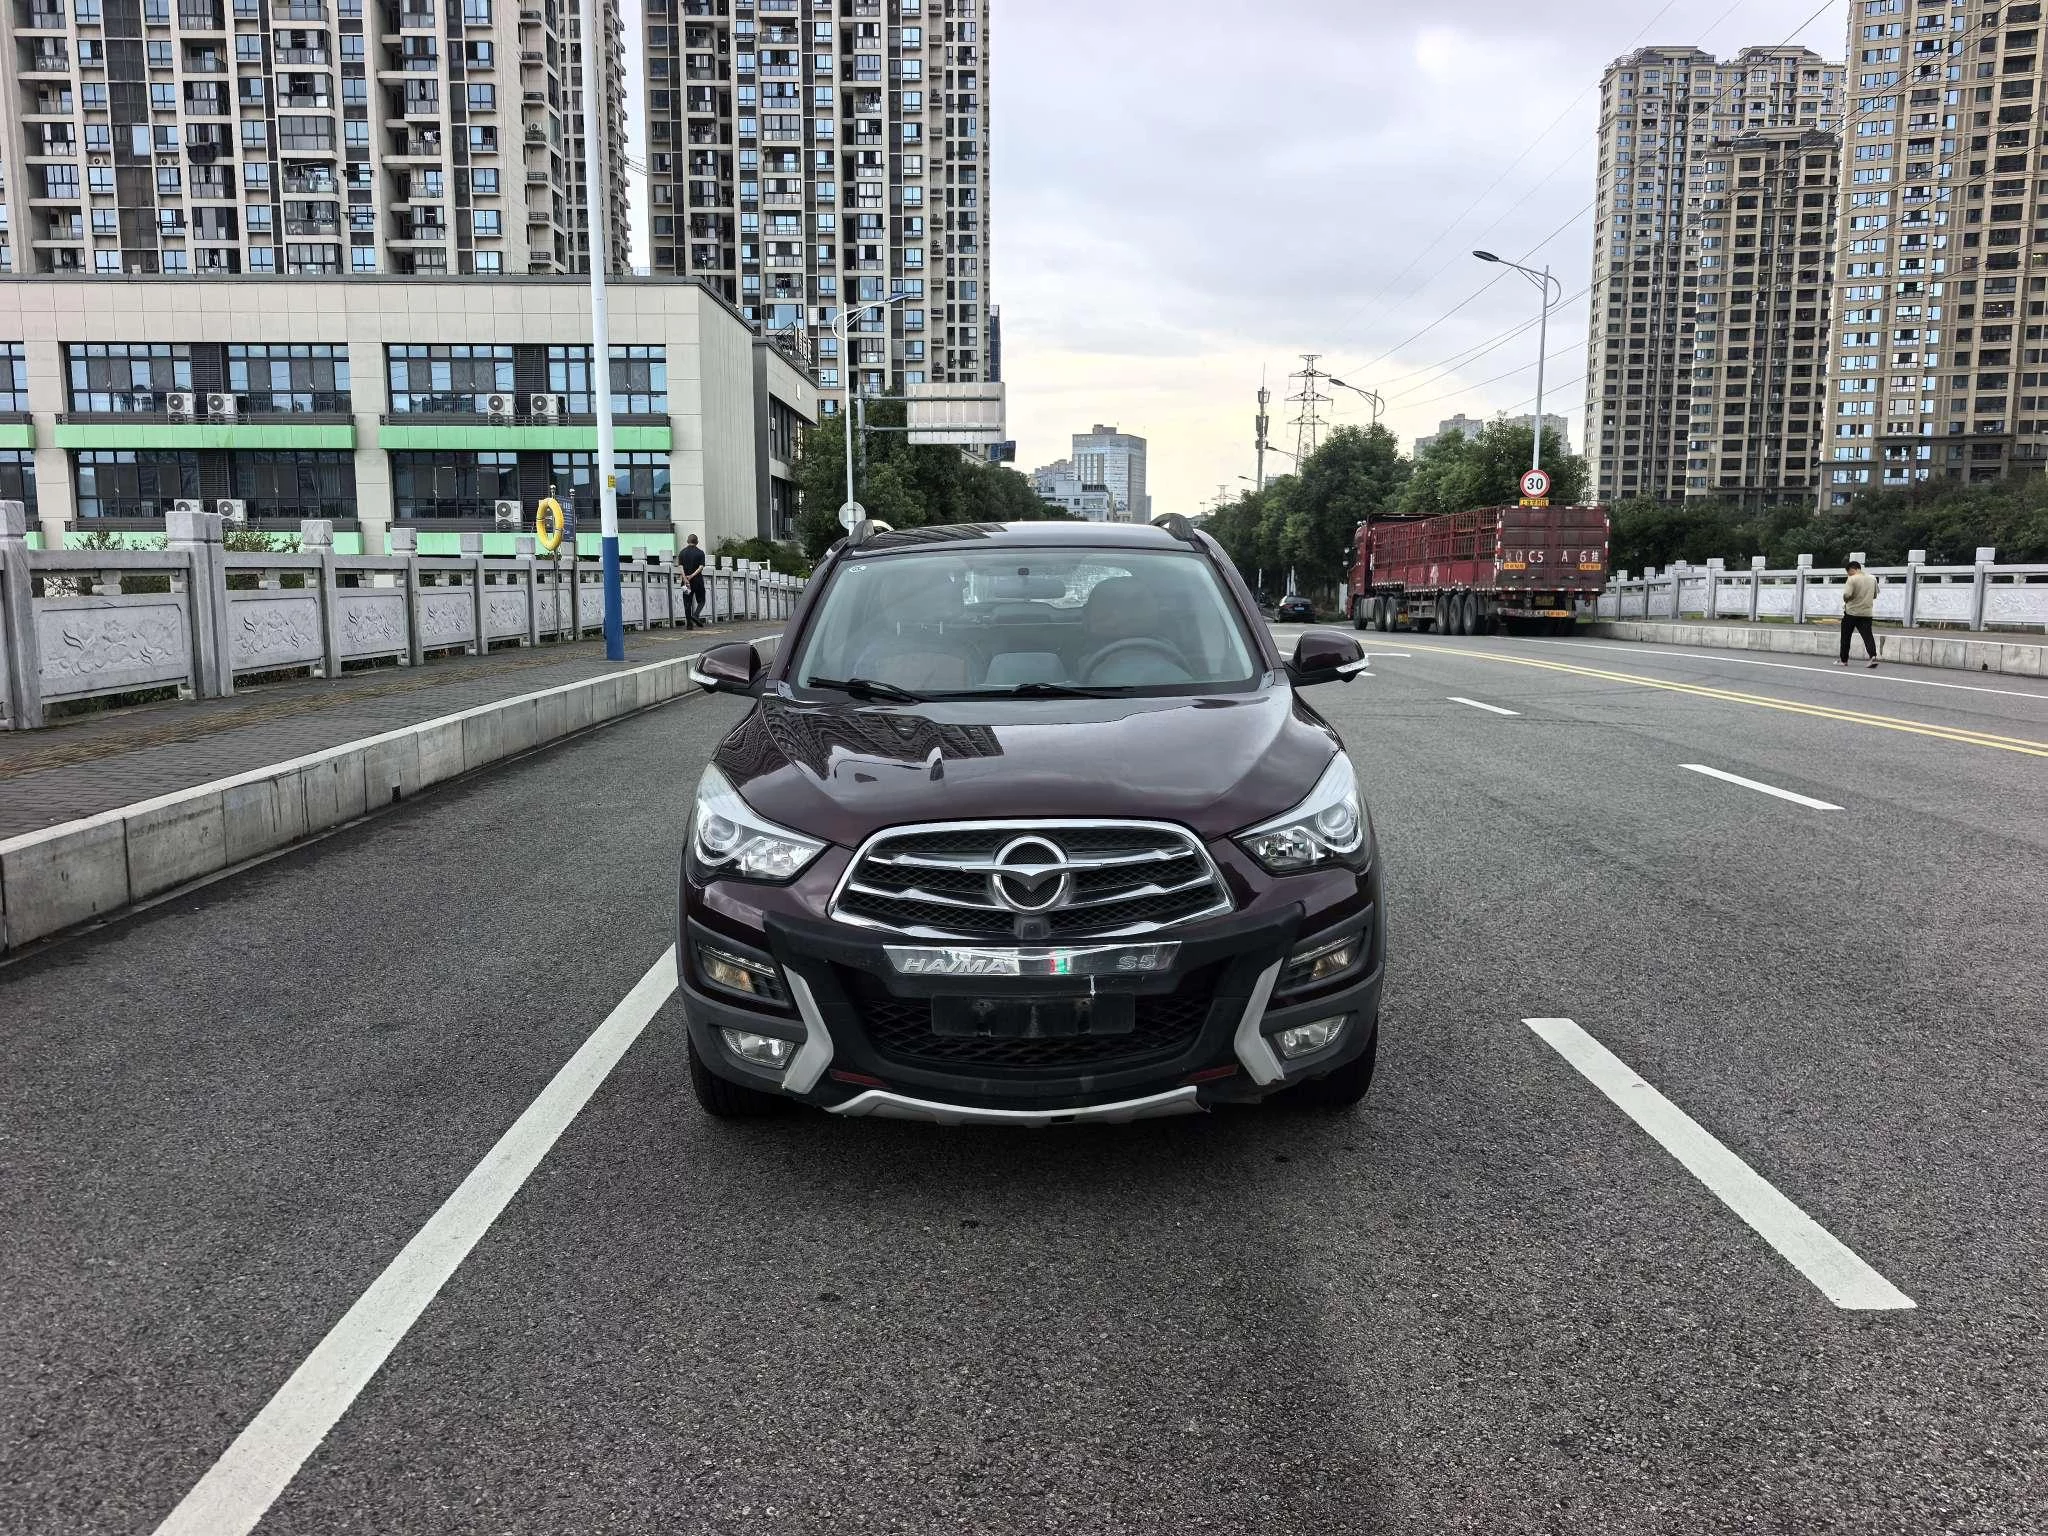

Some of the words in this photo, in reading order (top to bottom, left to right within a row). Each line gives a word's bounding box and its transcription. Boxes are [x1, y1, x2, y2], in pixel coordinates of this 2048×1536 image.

[1527, 478, 1543, 490] 30
[902, 958, 1010, 974] HAIMA
[1118, 955, 1157, 970] S5
